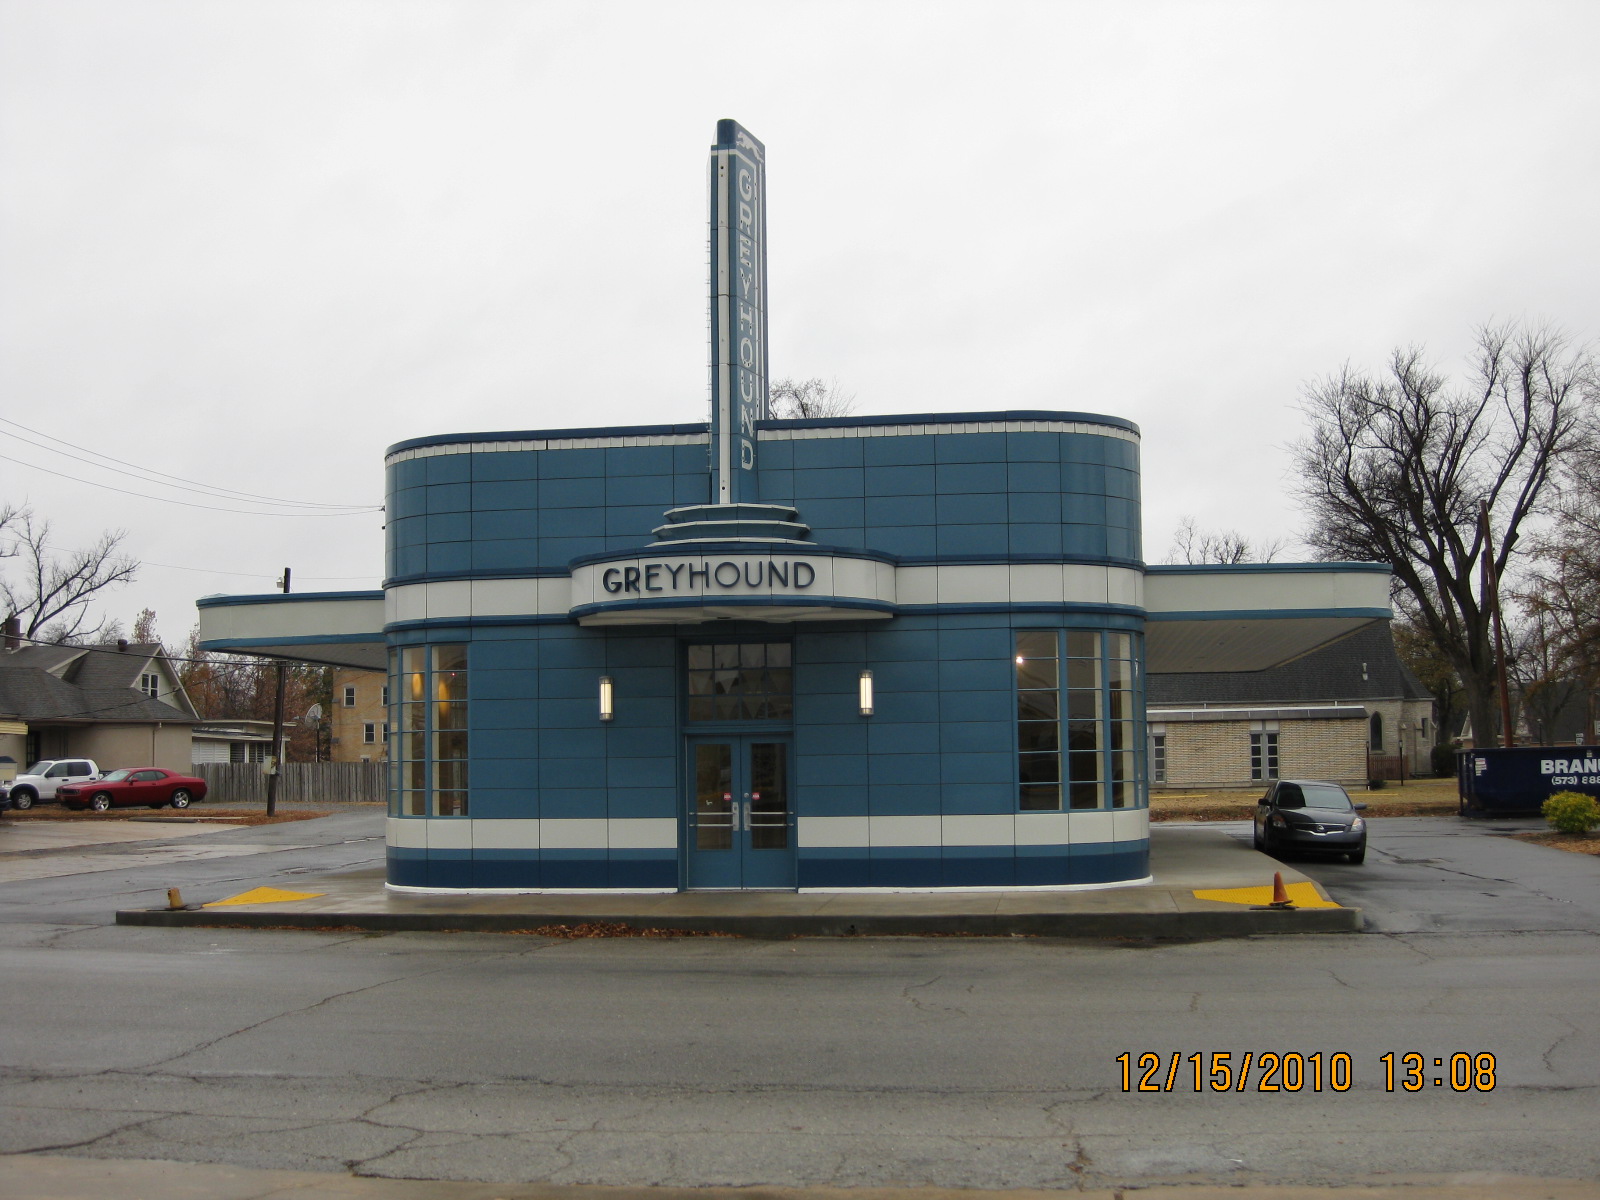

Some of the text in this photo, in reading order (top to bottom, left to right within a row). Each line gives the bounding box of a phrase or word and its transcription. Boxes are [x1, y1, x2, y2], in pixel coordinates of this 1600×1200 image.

[739, 168, 754, 471] GREYHOUND
[602, 561, 816, 593] GREYHOUND
[1541, 759, 1600, 774] BRAN
[1552, 776, 1577, 785] (573)
